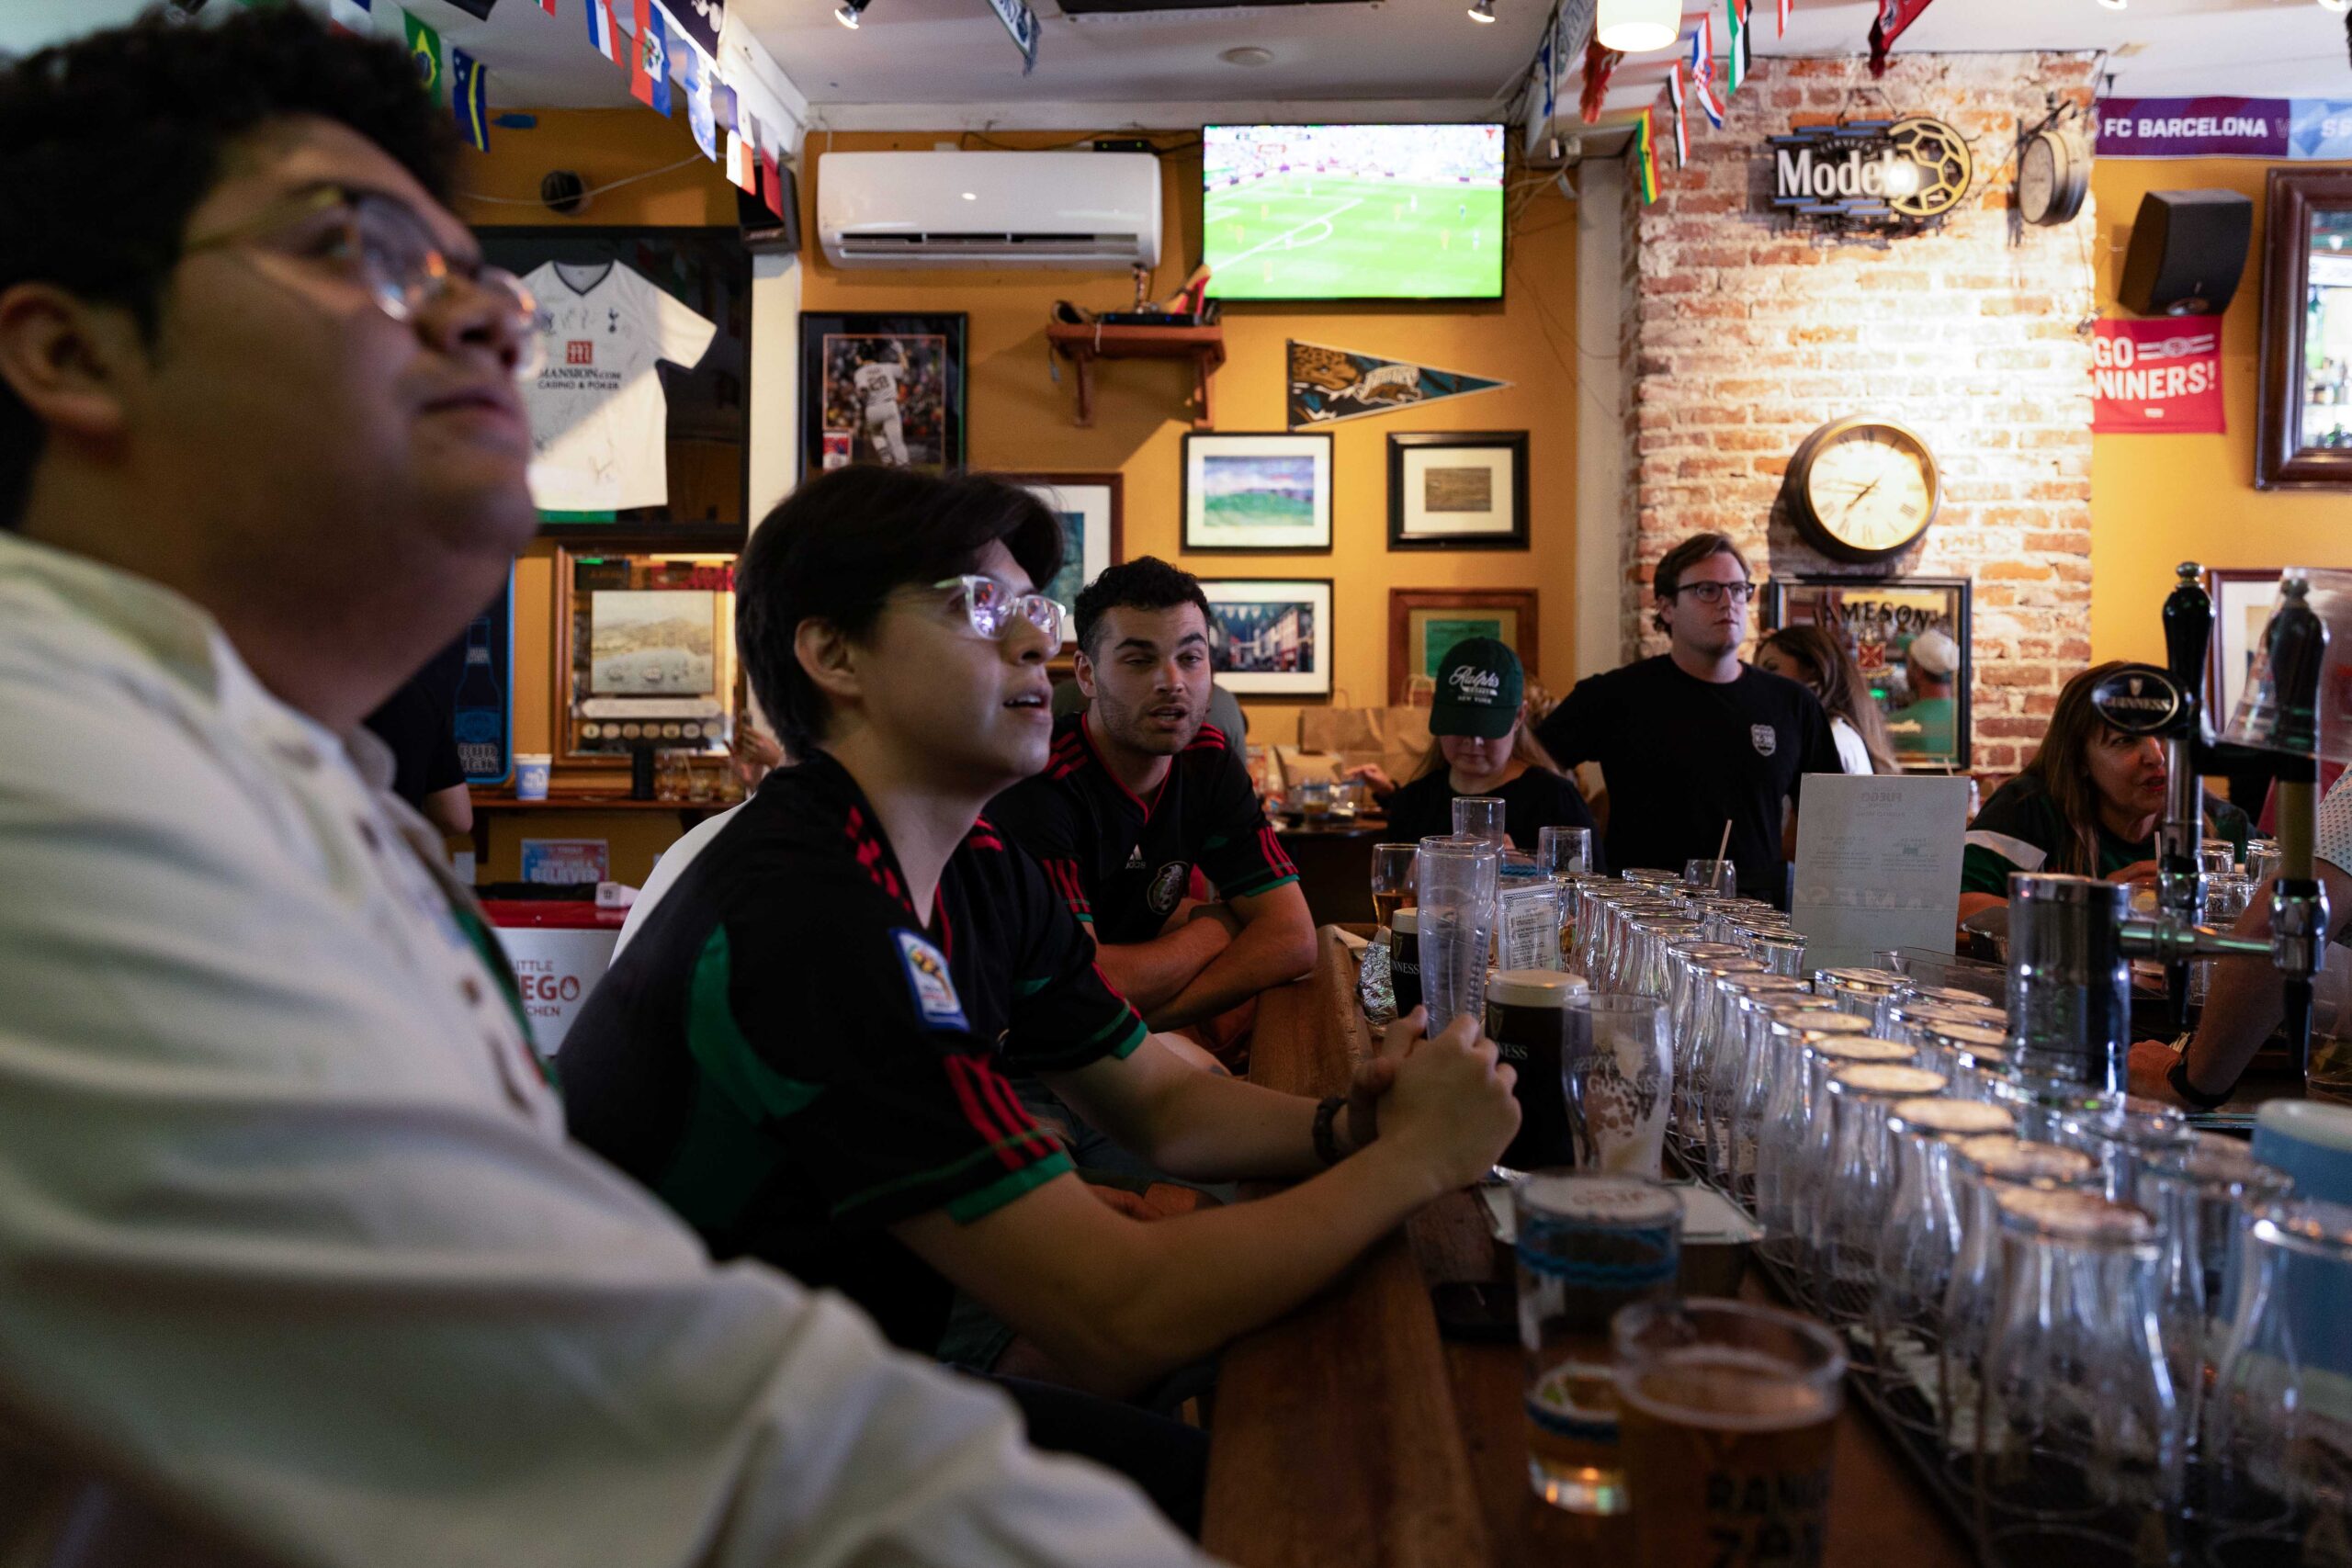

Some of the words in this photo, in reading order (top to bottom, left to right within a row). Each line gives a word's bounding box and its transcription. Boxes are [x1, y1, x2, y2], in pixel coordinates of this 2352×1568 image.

[2104, 118, 2132, 138] FC
[2137, 117, 2268, 139] BARCELONA
[1776, 148, 1919, 197] Model
[2093, 335, 2135, 369] GO
[588, 380, 619, 390] POKER
[2093, 359, 2216, 400] NINERS!
[515, 959, 554, 972] ITTLE
[1391, 959, 1419, 976] NNESS
[520, 975, 582, 1002] EGO
[525, 1005, 561, 1018] CHEN
[1498, 1042, 1529, 1060] NESS
